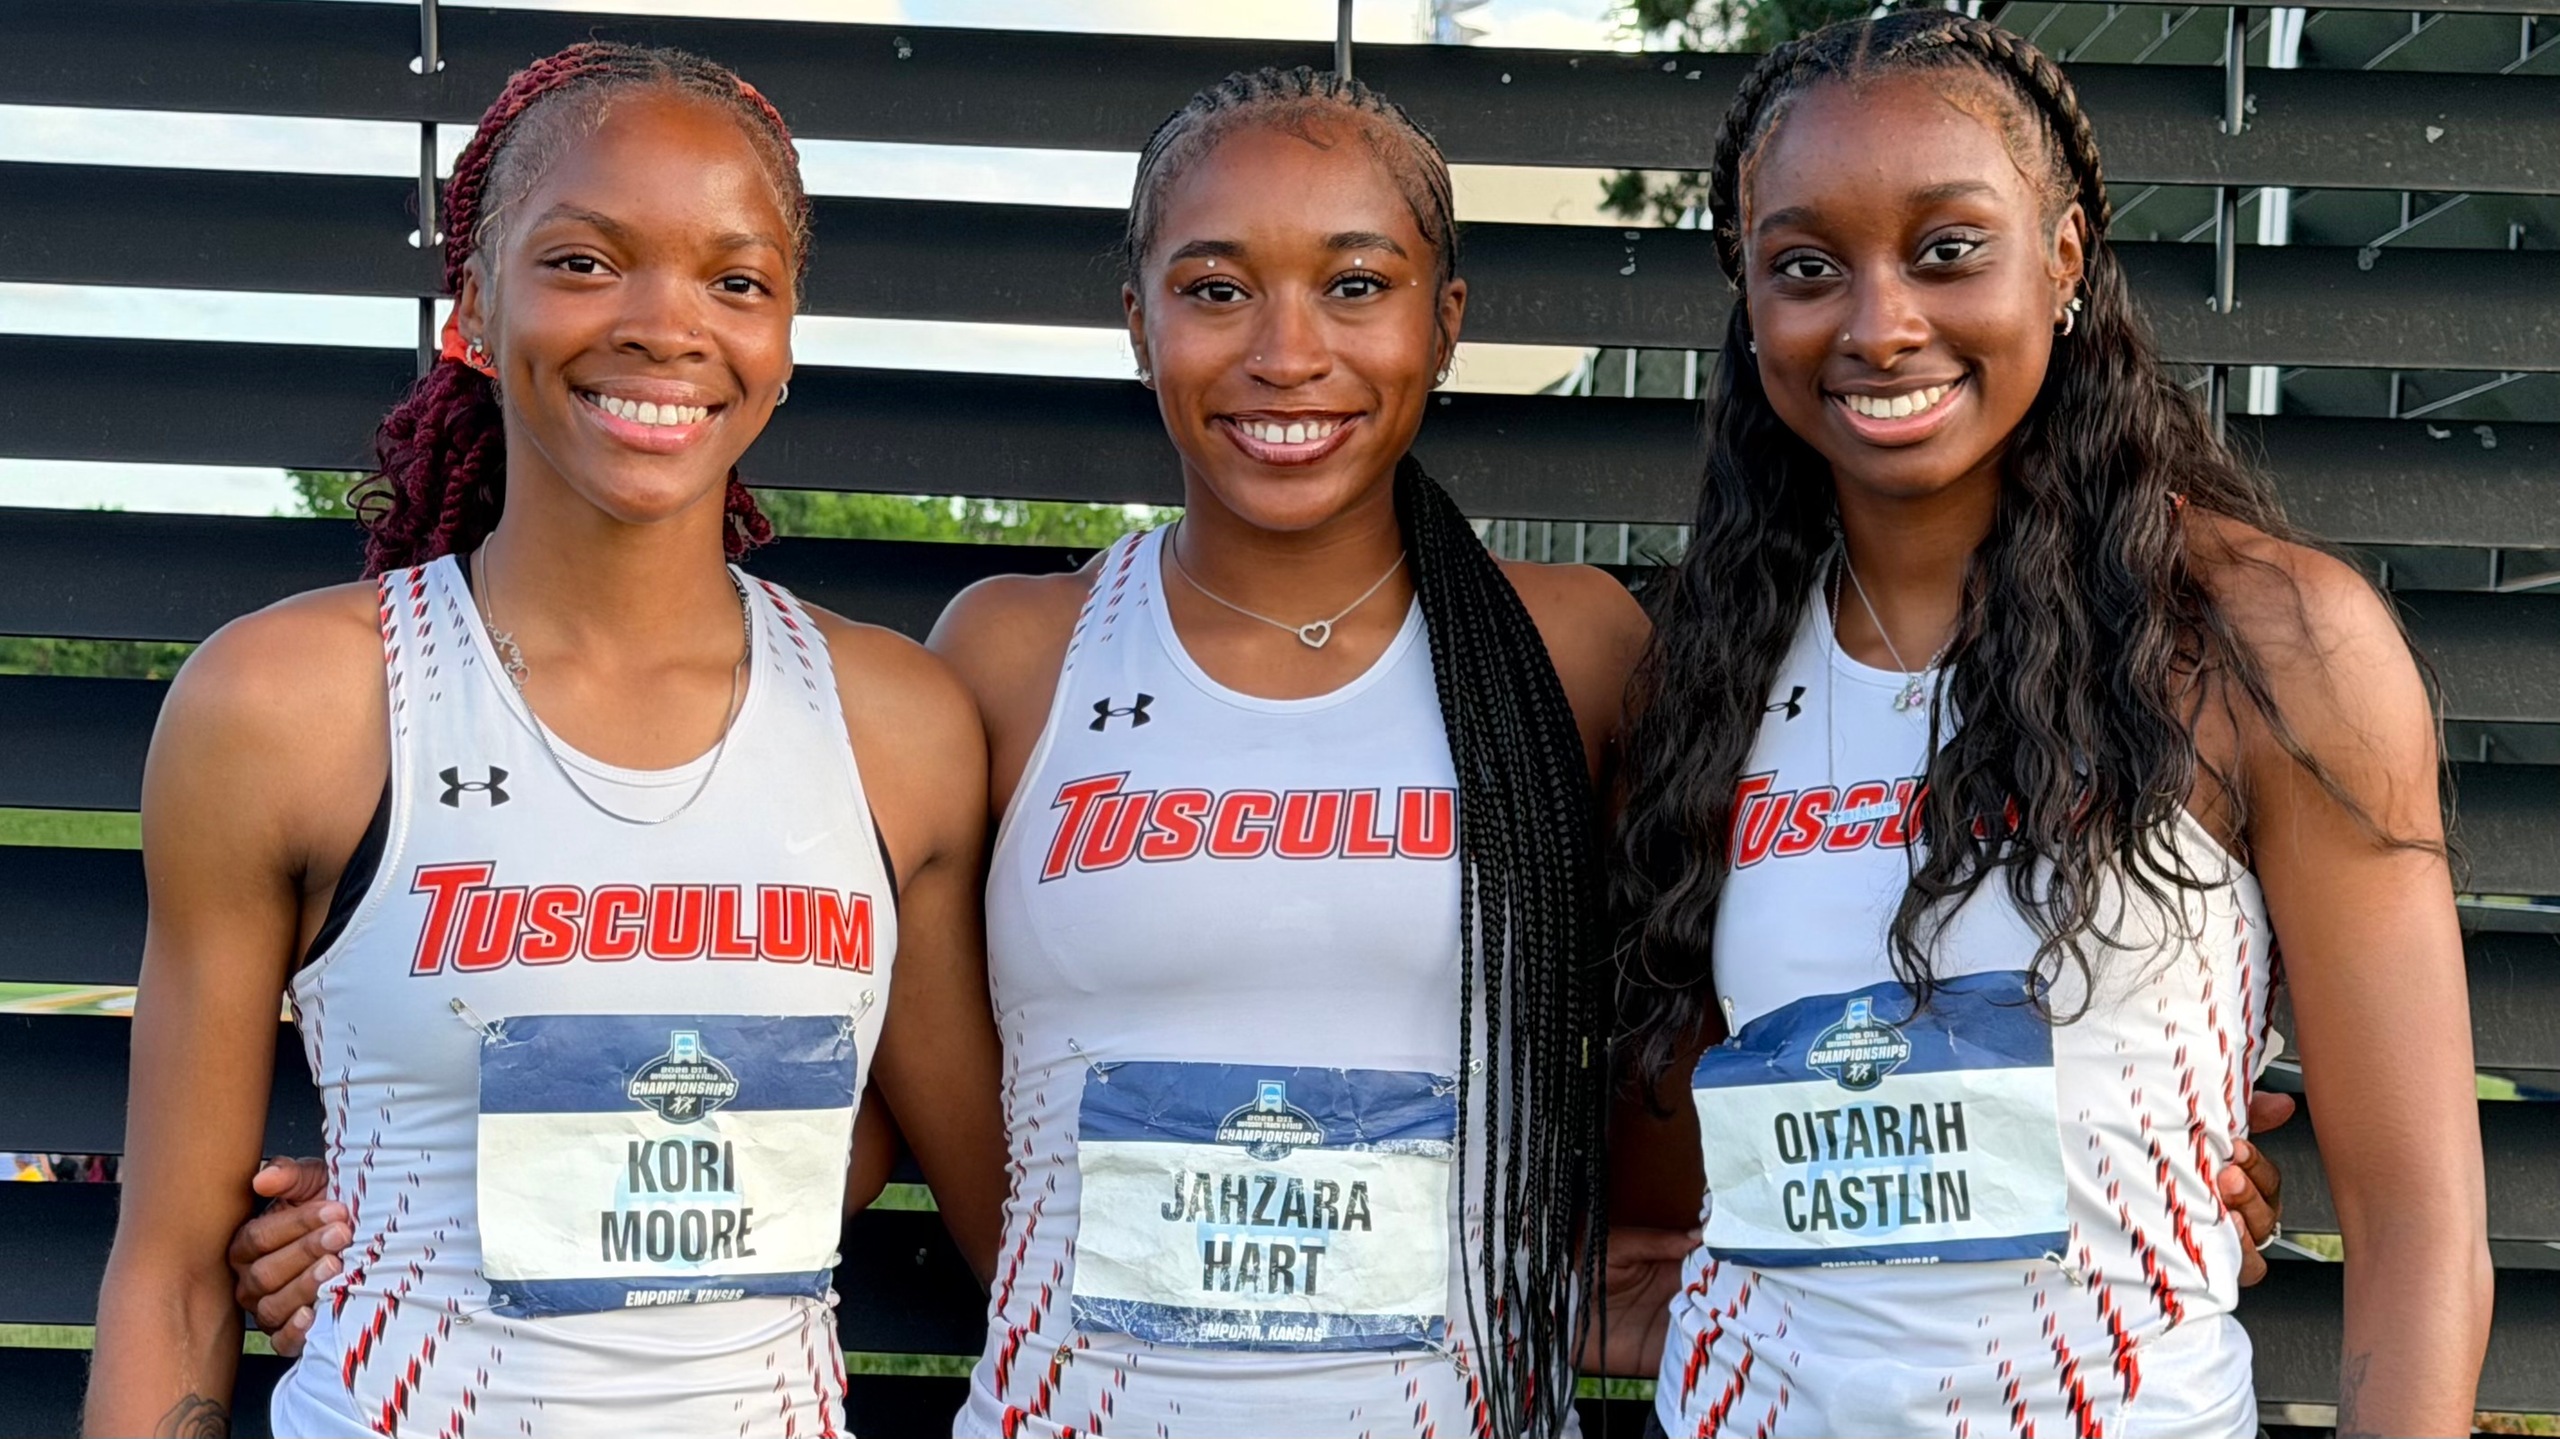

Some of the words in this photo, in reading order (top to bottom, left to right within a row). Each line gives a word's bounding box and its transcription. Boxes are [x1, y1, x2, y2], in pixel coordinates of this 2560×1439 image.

[1038, 770, 1458, 884] TUSCULU
[409, 860, 874, 977] TUSCULUM
[1810, 1044, 1907, 1064] CHAMPIONSHIPS
[632, 1081, 735, 1097] CHAMPIONSHIPS
[1220, 1128, 1321, 1145] CHAMPIONSHIPS
[1774, 1101, 1968, 1164] QITARAH
[628, 1139, 735, 1193] KORI
[1161, 1171, 1372, 1231] JAHZARA
[1782, 1170, 1971, 1232] CASTLIN
[601, 1207, 757, 1262] MOORE
[1203, 1240, 1326, 1296] HART
[694, 1288, 745, 1304] KANSAS
[1267, 1325, 1323, 1342] KANSAS
